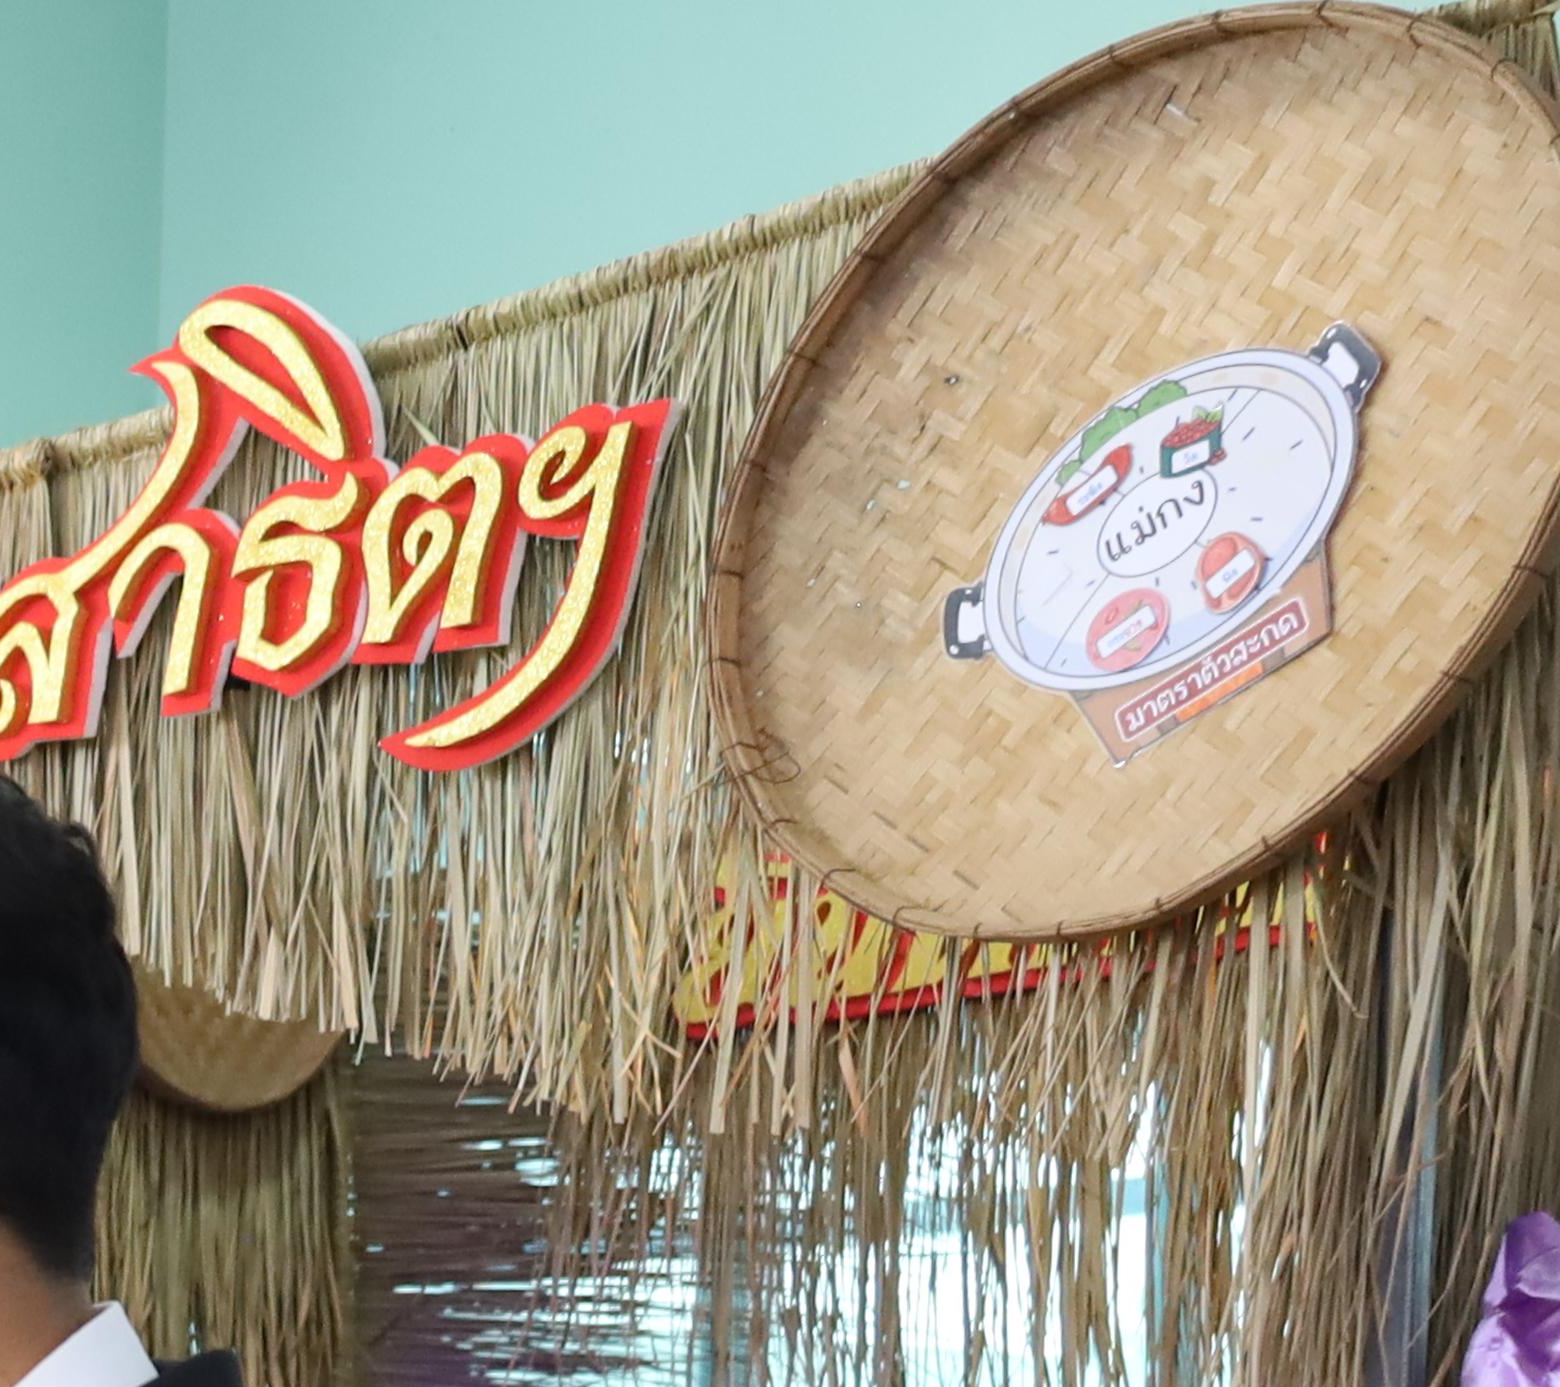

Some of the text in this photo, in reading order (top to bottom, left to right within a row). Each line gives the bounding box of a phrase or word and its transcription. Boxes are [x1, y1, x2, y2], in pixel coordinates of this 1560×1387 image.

[1102, 476, 1208, 565] แม่กง
[1123, 610, 1299, 734] มาตราตัวสะกด
